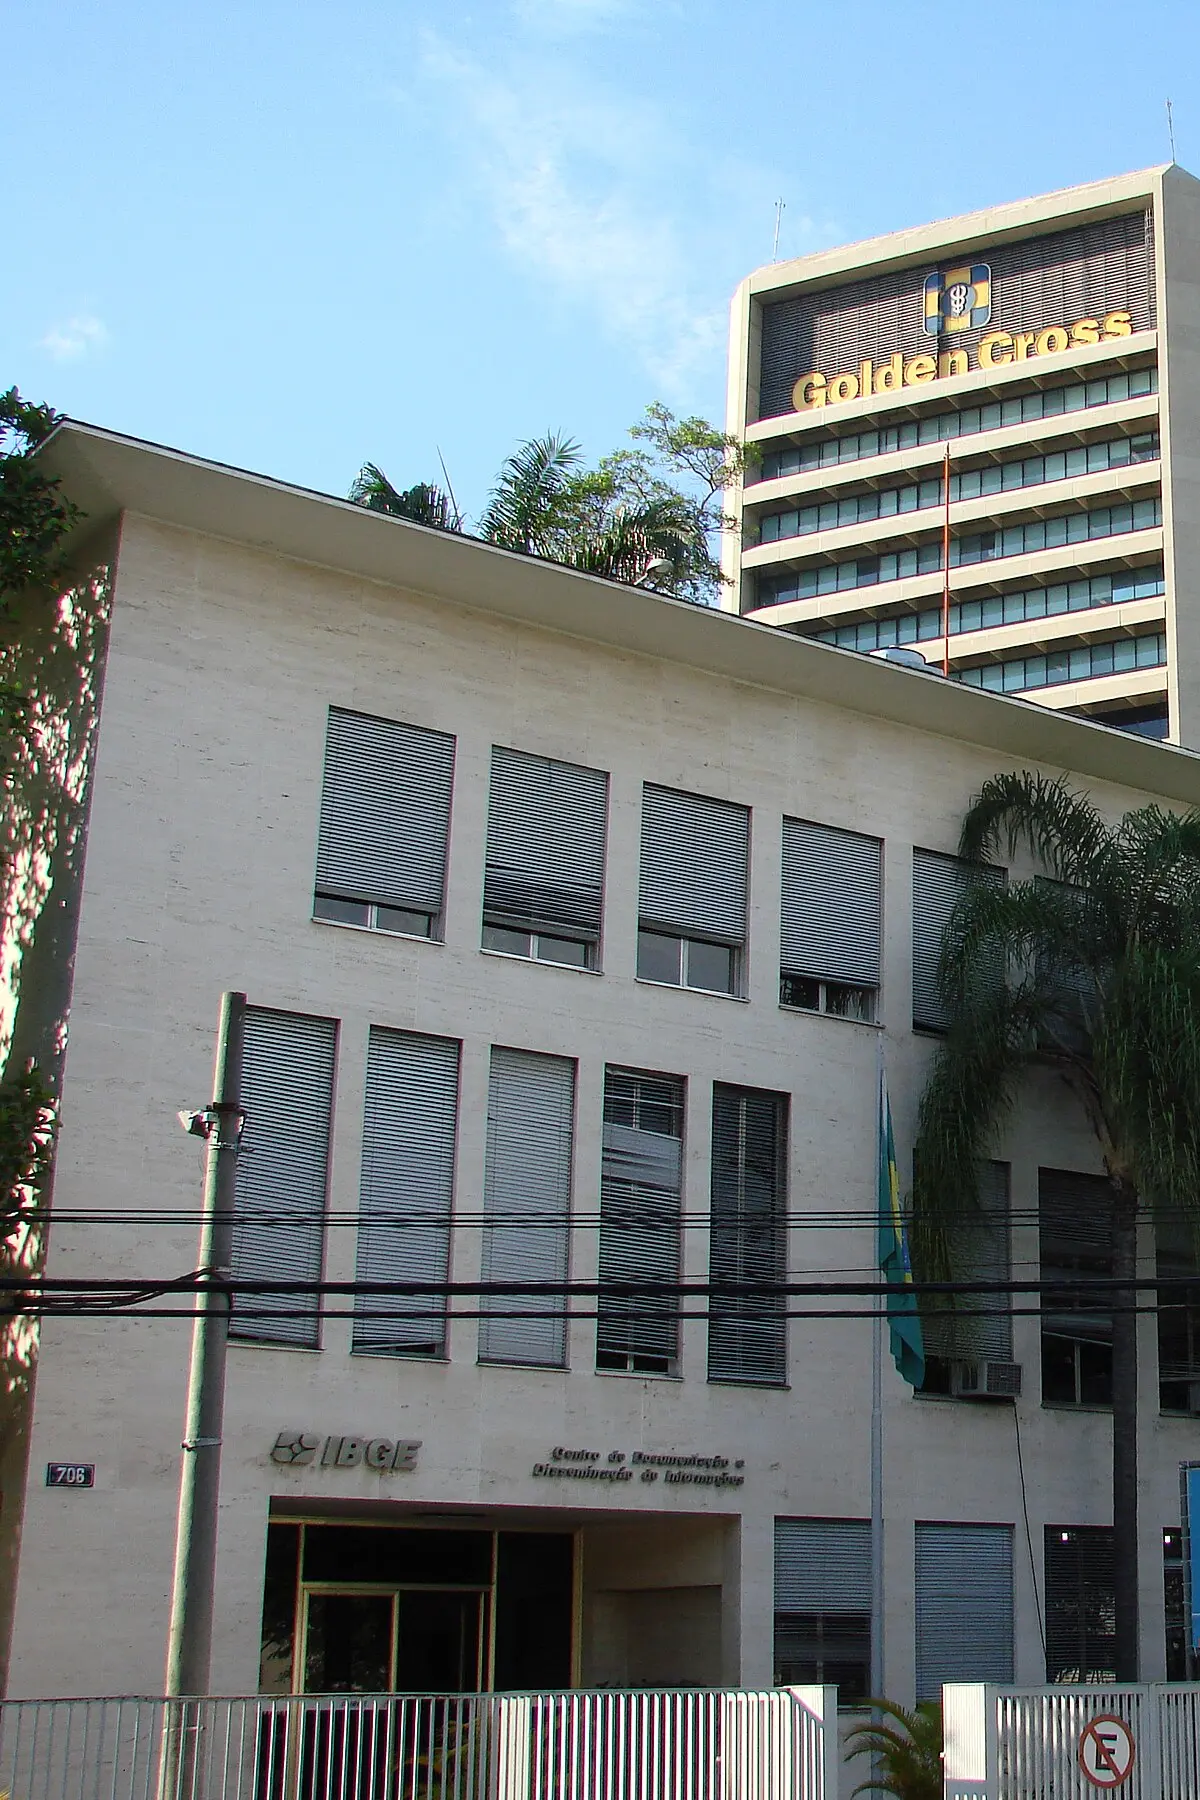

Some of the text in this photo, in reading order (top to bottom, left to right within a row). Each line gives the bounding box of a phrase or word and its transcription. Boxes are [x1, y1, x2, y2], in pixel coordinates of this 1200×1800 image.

[792, 311, 1133, 413] Golden Cross
[320, 1435, 422, 1471] IBGE
[552, 1446, 600, 1461] Centro
[735, 1459, 745, 1468] e
[56, 1467, 85, 1484] 706
[1095, 1733, 1117, 1770] E
